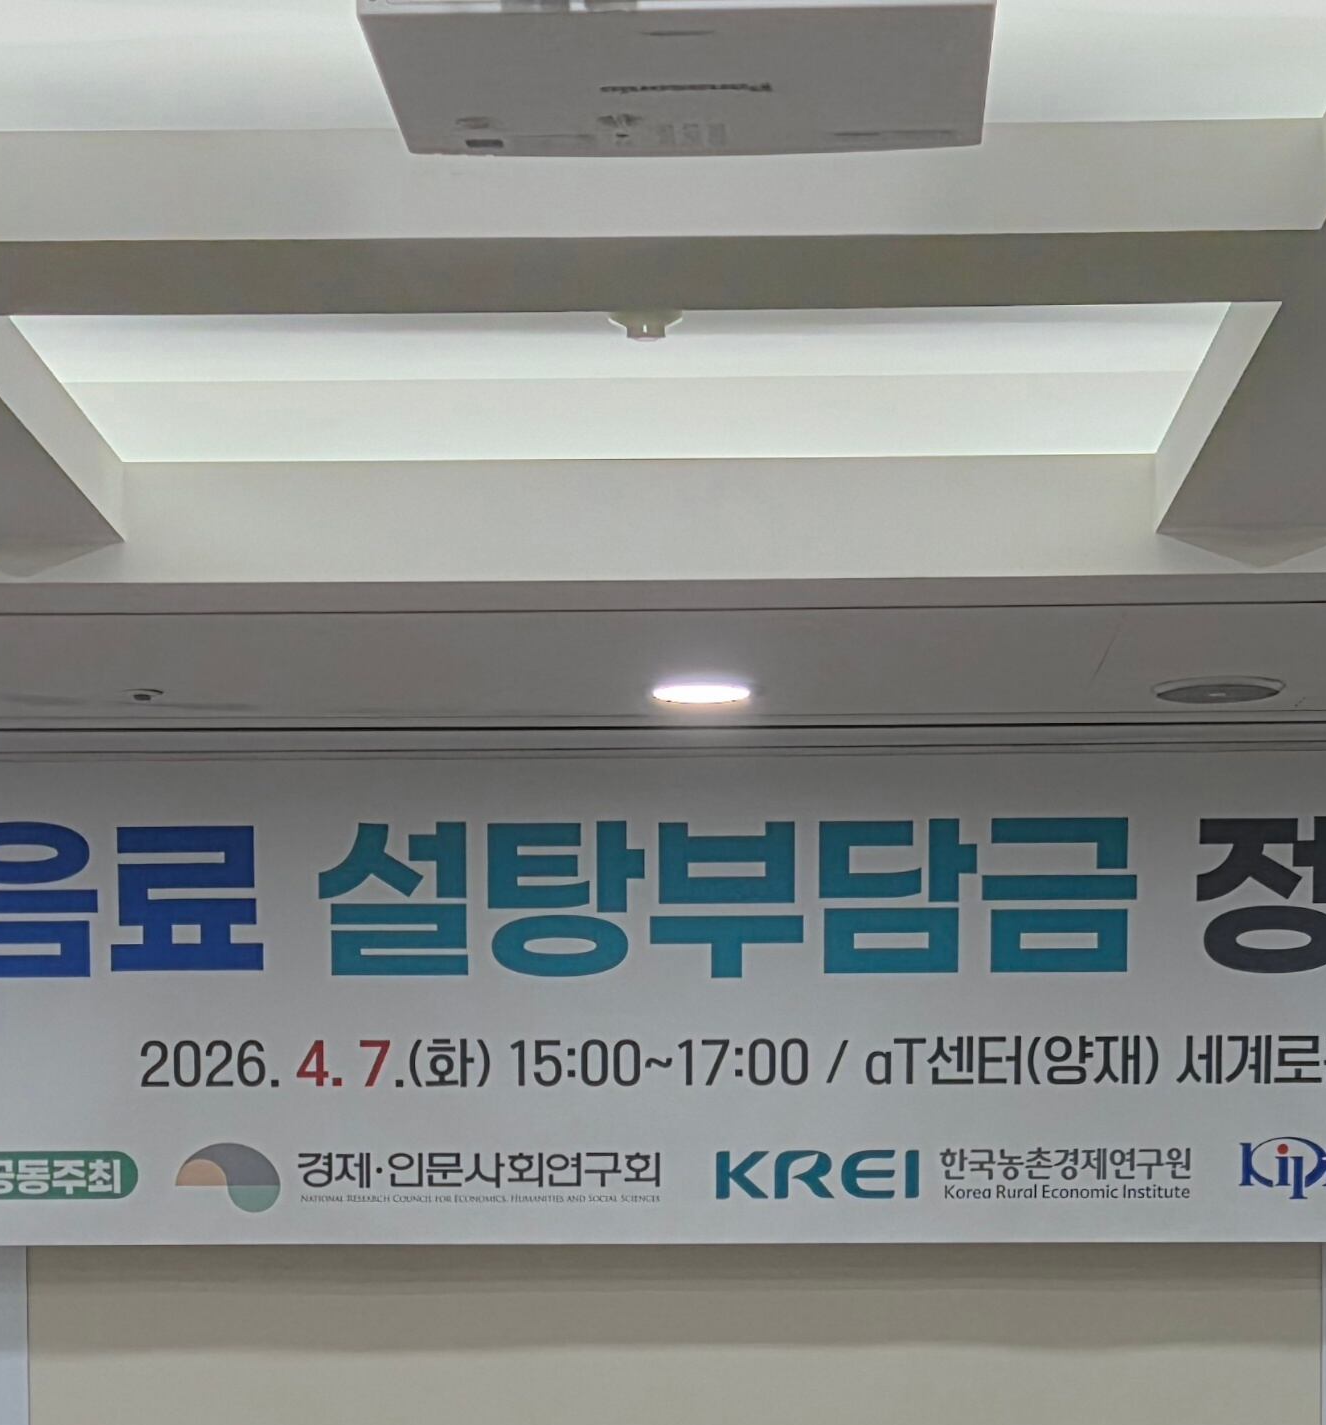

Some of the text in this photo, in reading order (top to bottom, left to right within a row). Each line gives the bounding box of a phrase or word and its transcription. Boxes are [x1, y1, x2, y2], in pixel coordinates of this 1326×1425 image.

[318, 816, 1138, 979] 설탕부담금
[140, 1039, 280, 1088] 2026.
[296, 1039, 343, 1087] 4.
[510, 1037, 809, 1087] 15:00~17:00
[715, 1149, 920, 1200] KREI
[939, 1146, 1191, 1181] 한국농촌경제연구원
[944, 1183, 1190, 1200] Korea Rural Economic Institute
